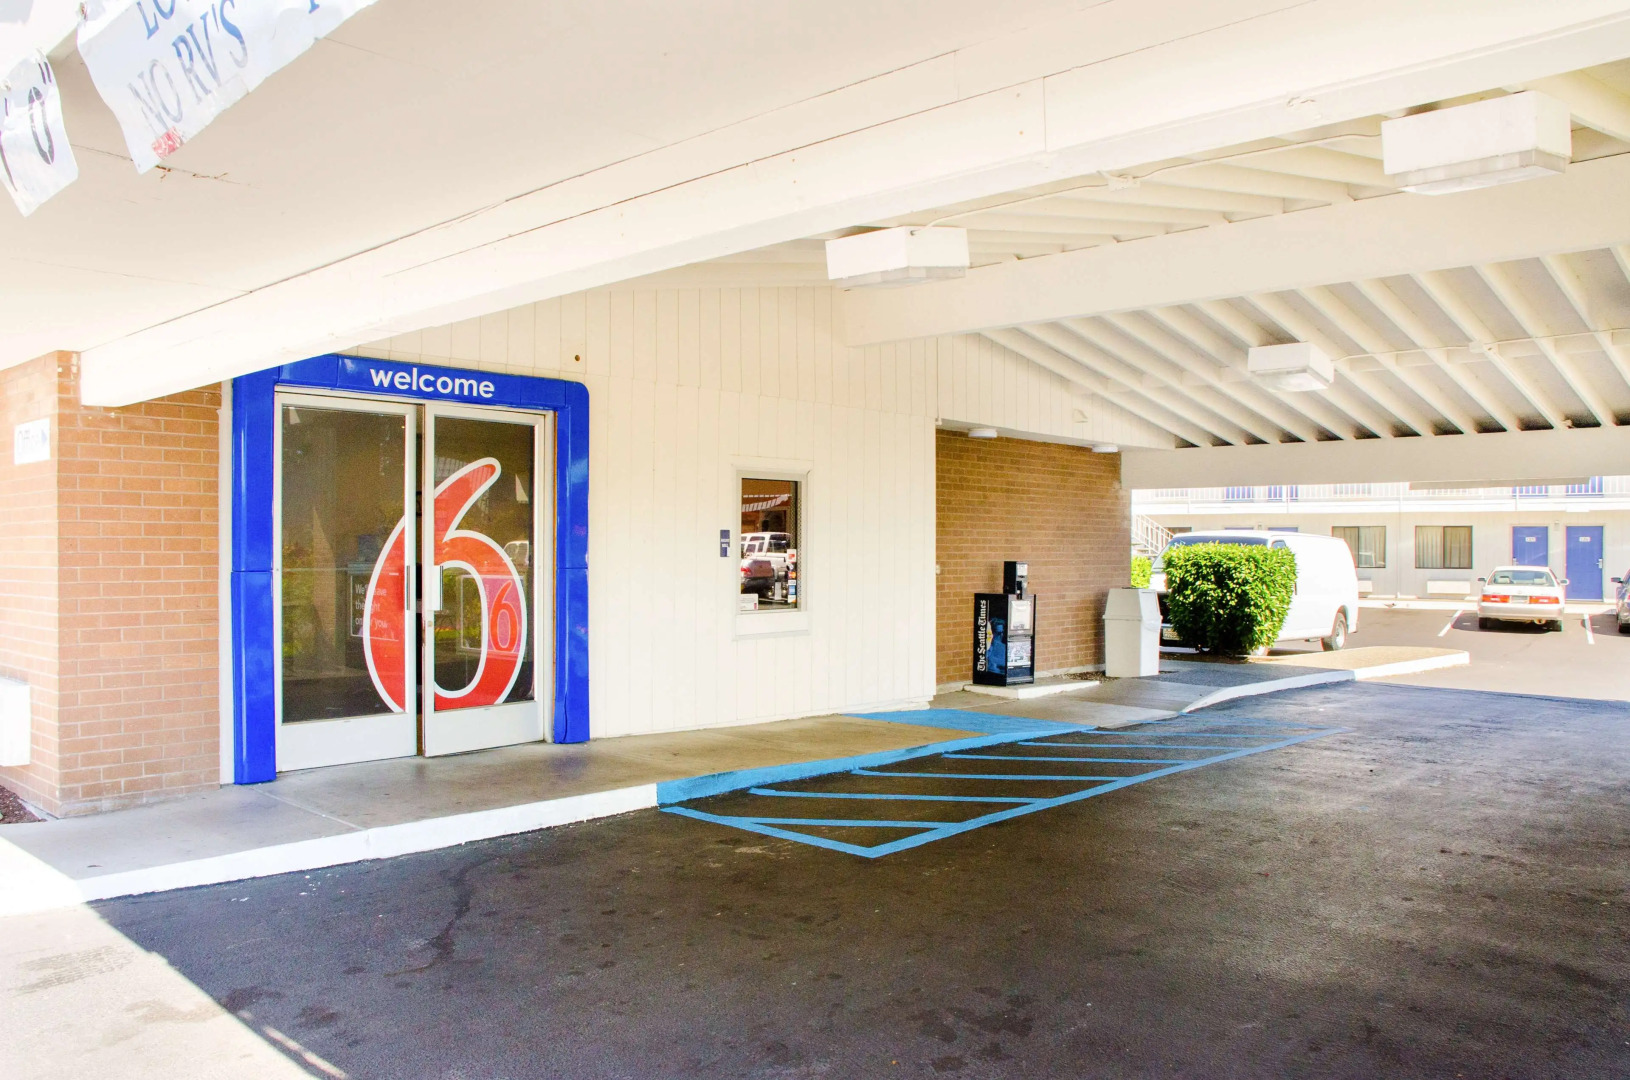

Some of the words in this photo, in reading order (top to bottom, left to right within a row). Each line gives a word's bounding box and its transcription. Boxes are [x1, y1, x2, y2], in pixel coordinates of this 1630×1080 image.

[127, 58, 184, 138] NO
[171, 0, 249, 105] RV'S
[370, 367, 495, 398] welcome
[363, 456, 528, 713] 6
[490, 580, 519, 652] 6
[978, 599, 986, 626] Times
[977, 627, 985, 654] Seattle
[977, 656, 985, 672] The
